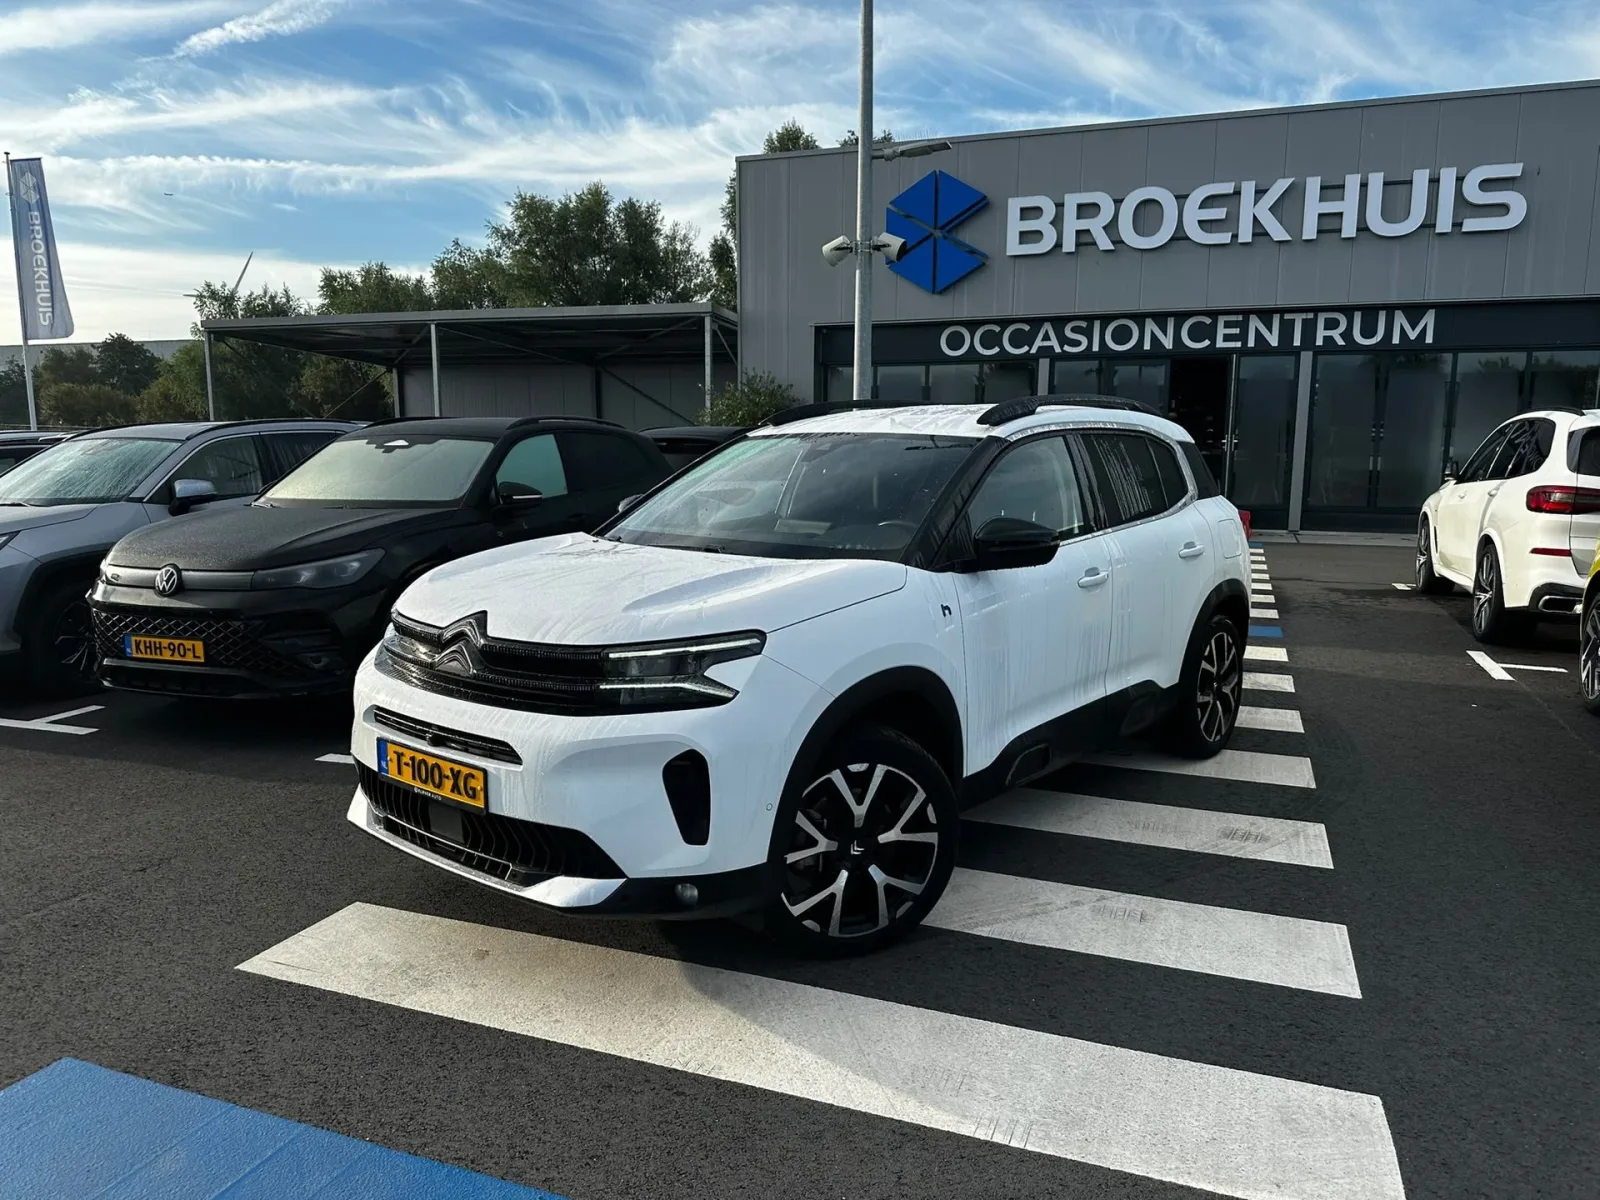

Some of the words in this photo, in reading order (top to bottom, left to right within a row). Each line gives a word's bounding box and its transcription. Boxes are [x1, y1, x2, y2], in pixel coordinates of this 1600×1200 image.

[1006, 162, 1528, 257] BROEKHUIS
[28, 211, 53, 326] BROEKHUIS
[939, 308, 1437, 357] OCCASIONCENTRUM
[134, 639, 202, 659] KHH-90-L
[393, 750, 477, 800] T-100-XG
